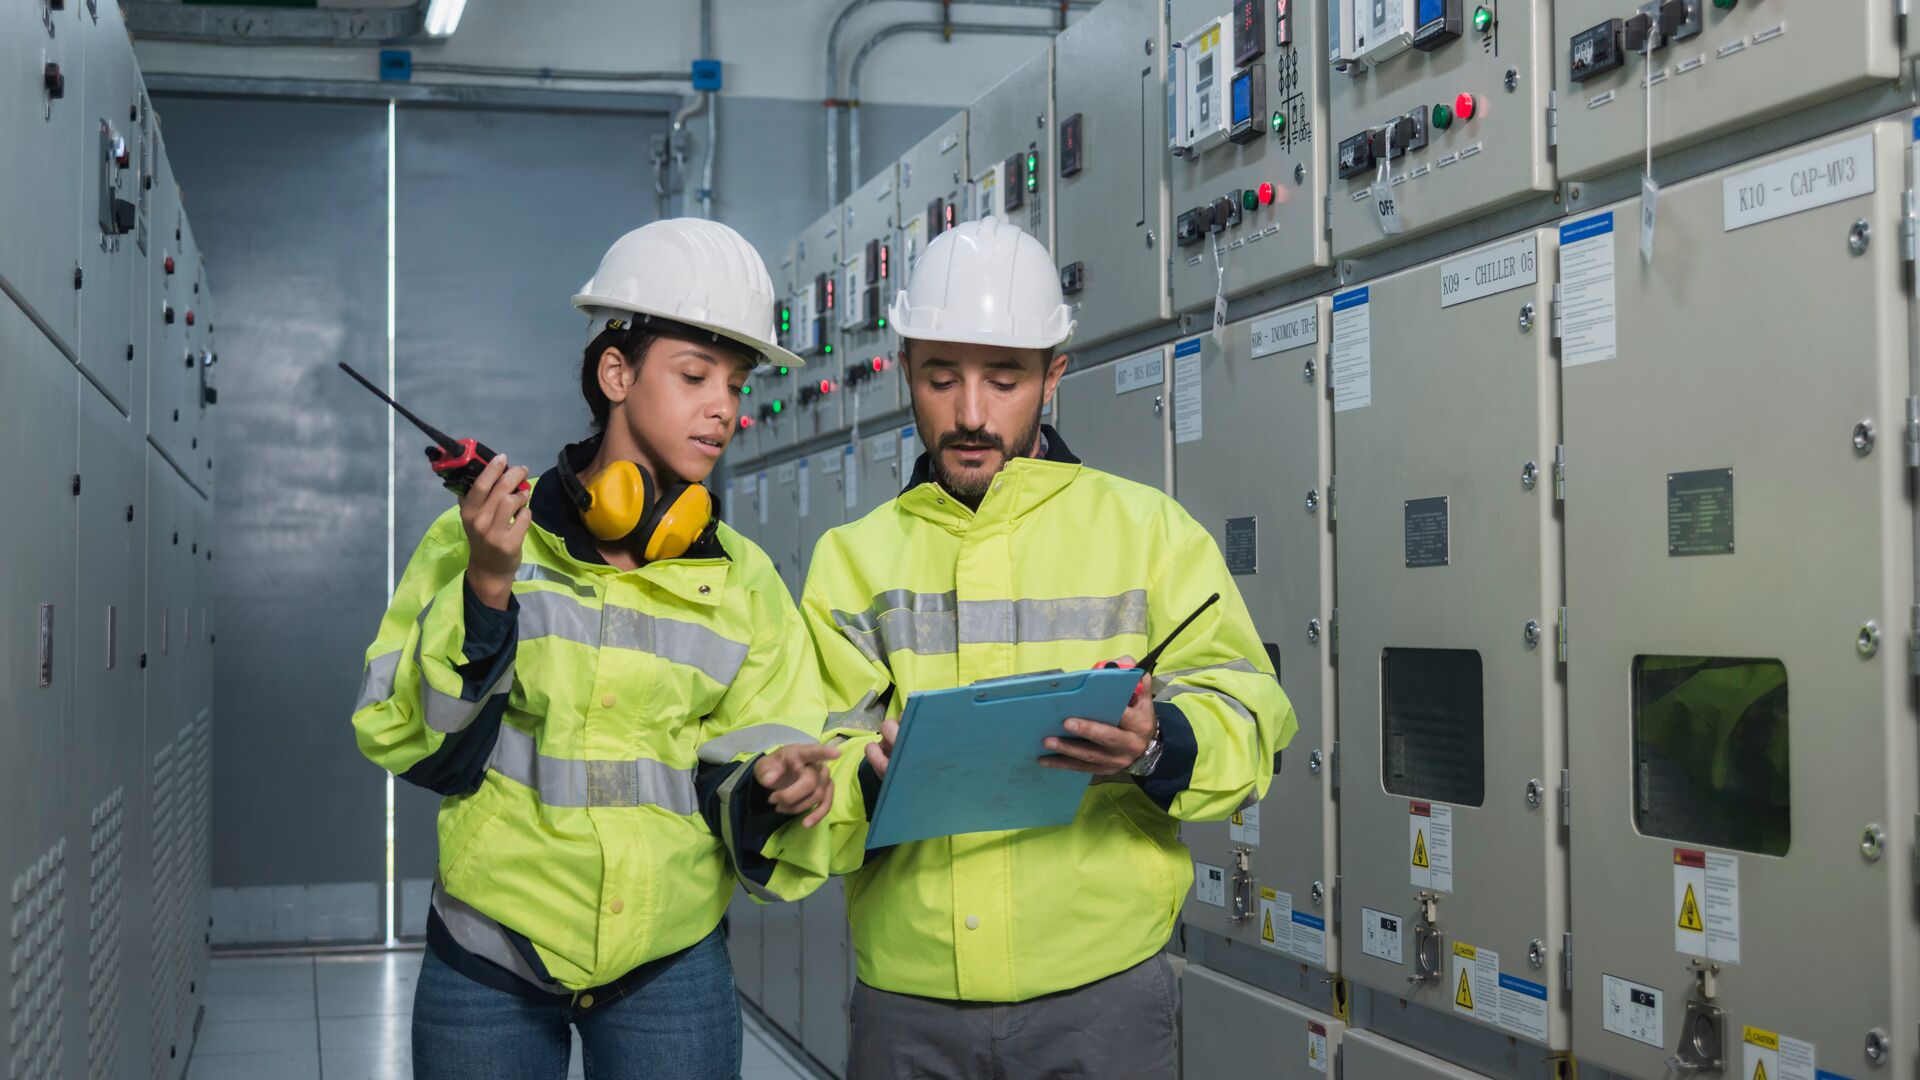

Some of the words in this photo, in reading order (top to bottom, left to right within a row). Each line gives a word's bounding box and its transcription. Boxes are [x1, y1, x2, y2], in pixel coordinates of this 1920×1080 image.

[1739, 183, 1765, 212] K10
[1790, 157, 1856, 197] CAP-MV3
[1378, 200, 1395, 216] OFF
[1443, 273, 1460, 295] K09
[1475, 256, 1516, 286] CHILLER
[1521, 251, 1534, 273] 05
[1271, 321, 1299, 343] INCOMING
[1301, 316, 1316, 335] TR-5
[1753, 1033, 1776, 1046] CAUTION
